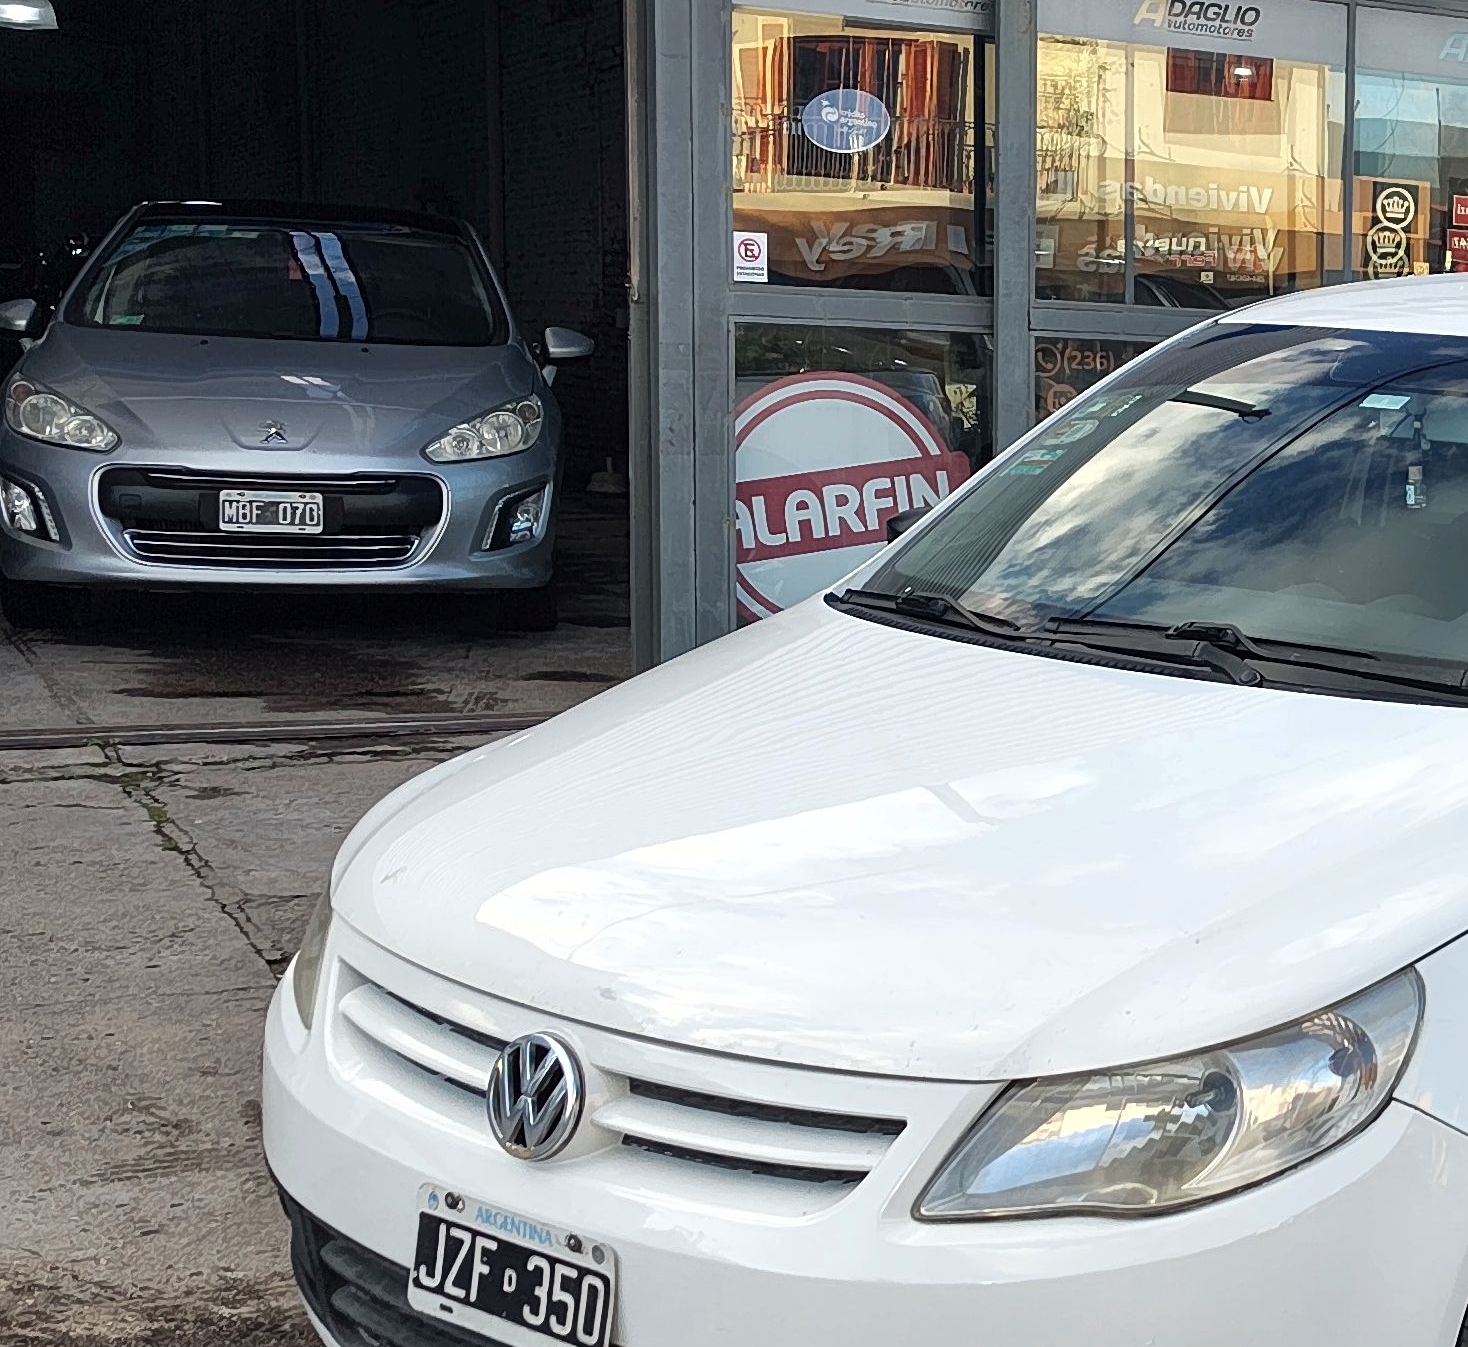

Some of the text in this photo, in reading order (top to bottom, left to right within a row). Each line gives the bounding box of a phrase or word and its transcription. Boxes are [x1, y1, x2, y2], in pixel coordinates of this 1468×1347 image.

[224, 501, 318, 525] MBF 070
[474, 1205, 554, 1247] ARGENTINA
[417, 1221, 499, 1303] JZF
[521, 1254, 606, 1346] 350
